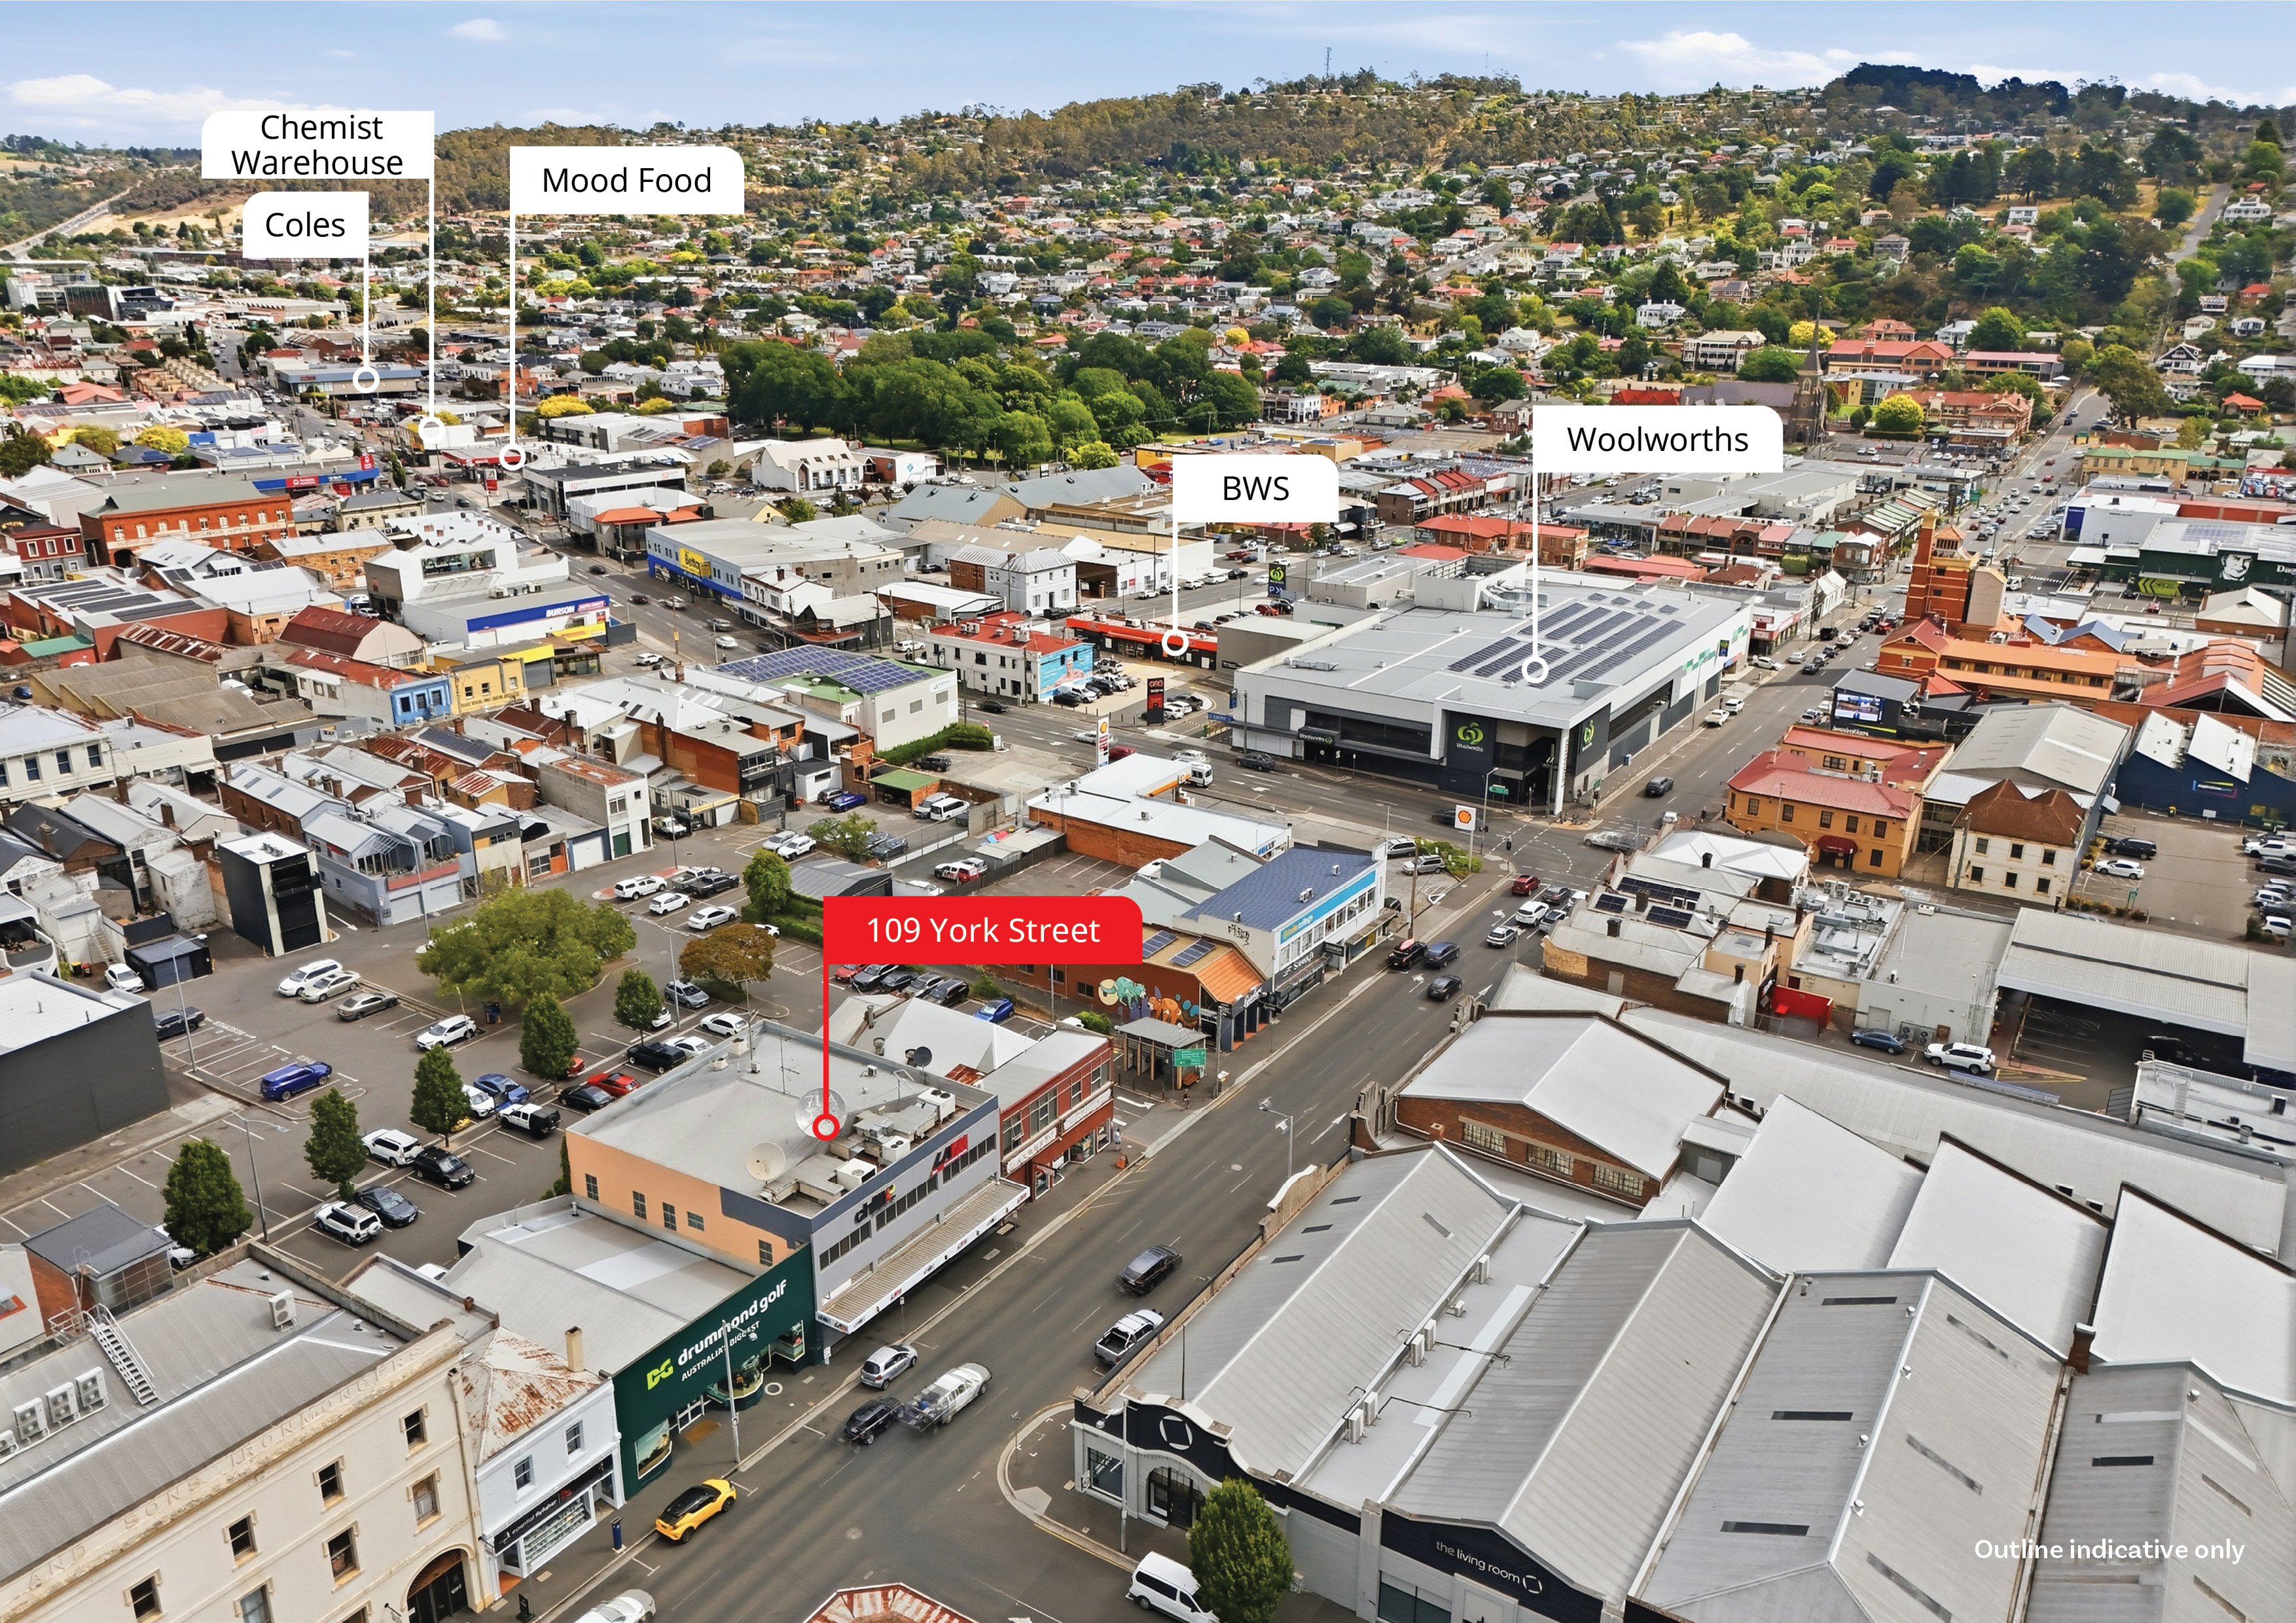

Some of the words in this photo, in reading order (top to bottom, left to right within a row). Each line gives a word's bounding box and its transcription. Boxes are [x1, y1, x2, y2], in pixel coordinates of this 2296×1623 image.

[546, 605, 575, 618] BURSON
[677, 1300, 758, 1366] drummond
[759, 1279, 787, 1313] golf
[124, 1478, 203, 1530] SONS
[230, 1347, 421, 1469] IRONMONGERS
[1436, 1541, 1455, 1556] the
[1456, 1548, 1486, 1571] living
[1487, 1563, 1520, 1584] room
